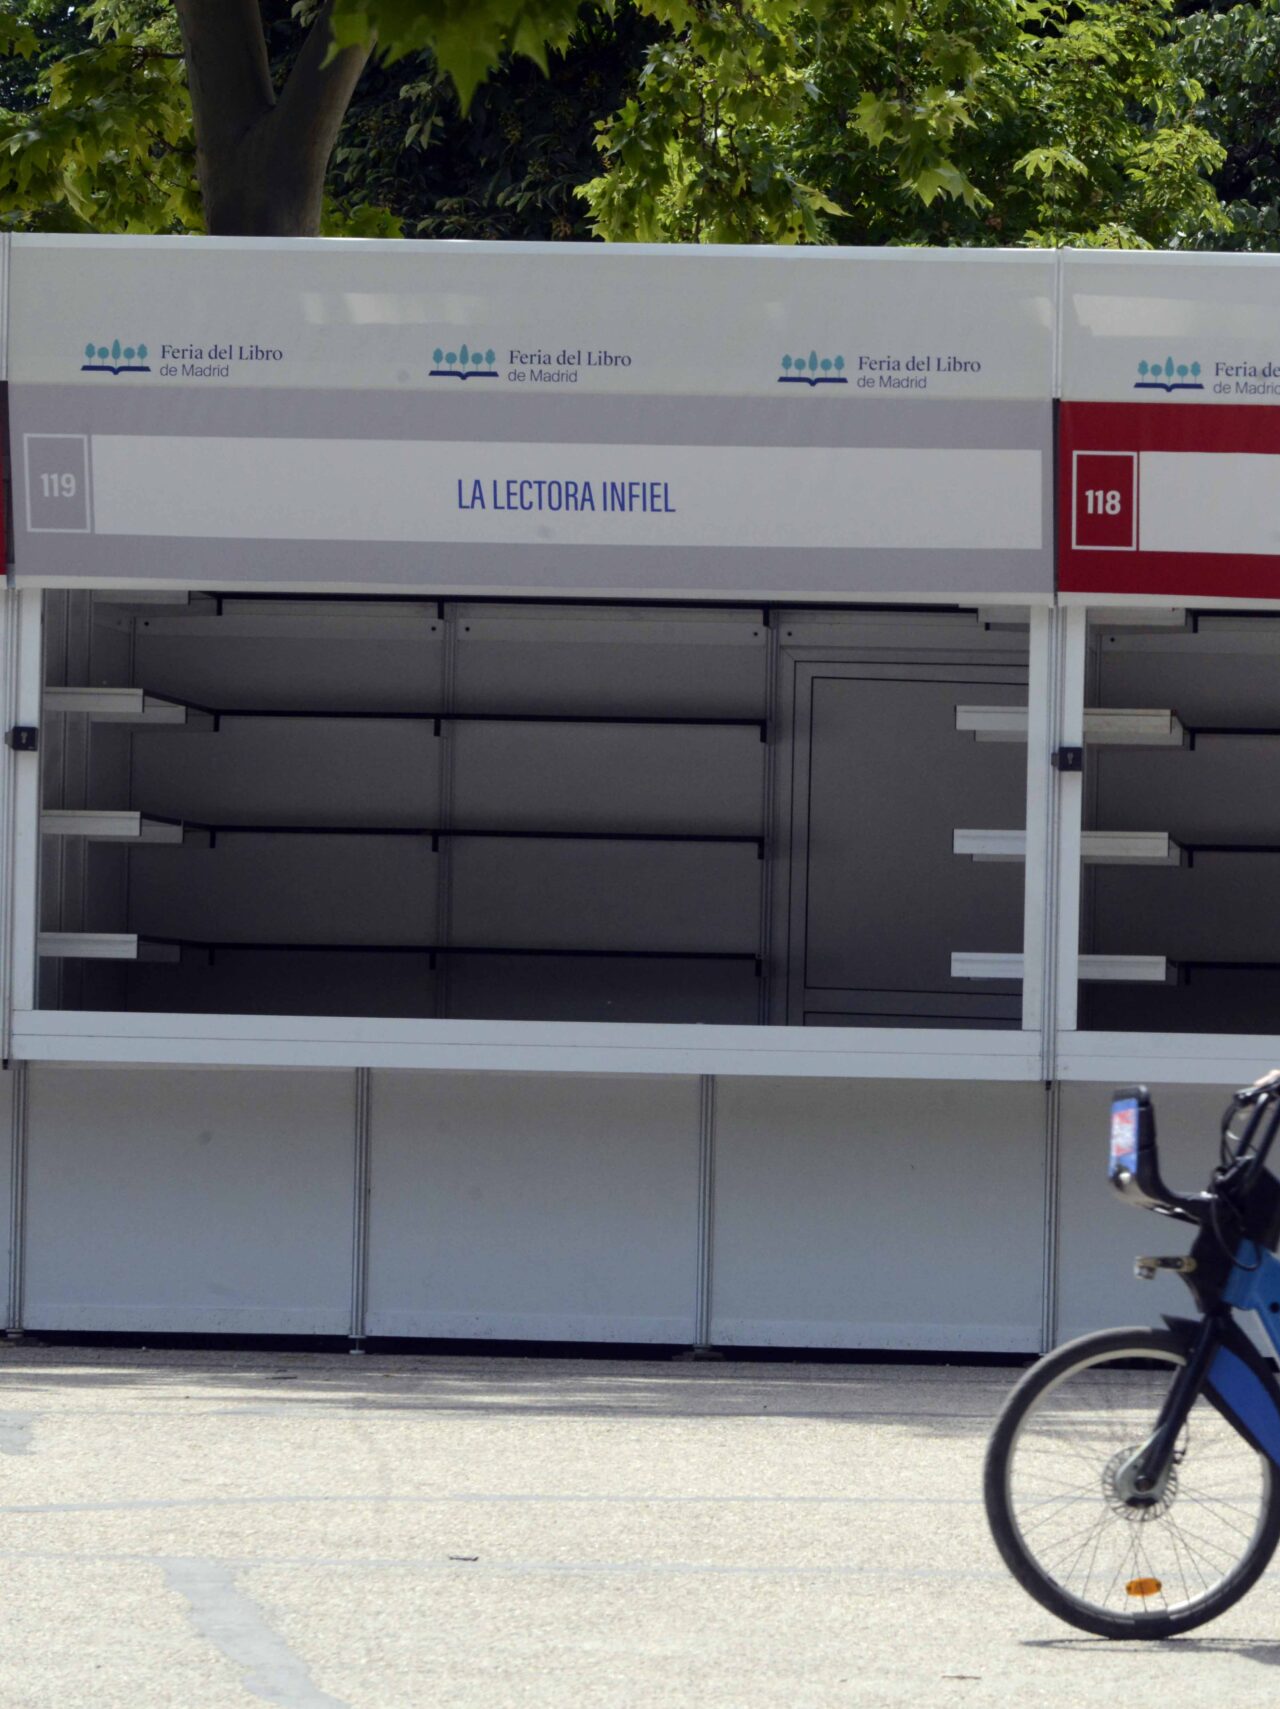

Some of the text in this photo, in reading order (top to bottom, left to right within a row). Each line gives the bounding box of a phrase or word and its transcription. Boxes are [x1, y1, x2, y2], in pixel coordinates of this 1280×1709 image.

[160, 343, 284, 361] Feria del Libro
[509, 349, 632, 367] Feria del Libro
[159, 363, 230, 378] de Madrid
[858, 355, 982, 373] Feria del Libro
[1214, 361, 1258, 378] Feria
[507, 368, 578, 383] de Madrid
[856, 374, 927, 389] de Madrid
[1212, 381, 1232, 394] de
[40, 472, 77, 498] 119
[456, 478, 677, 513] LA LECTORA INFIEL
[1084, 488, 1122, 516] 118
